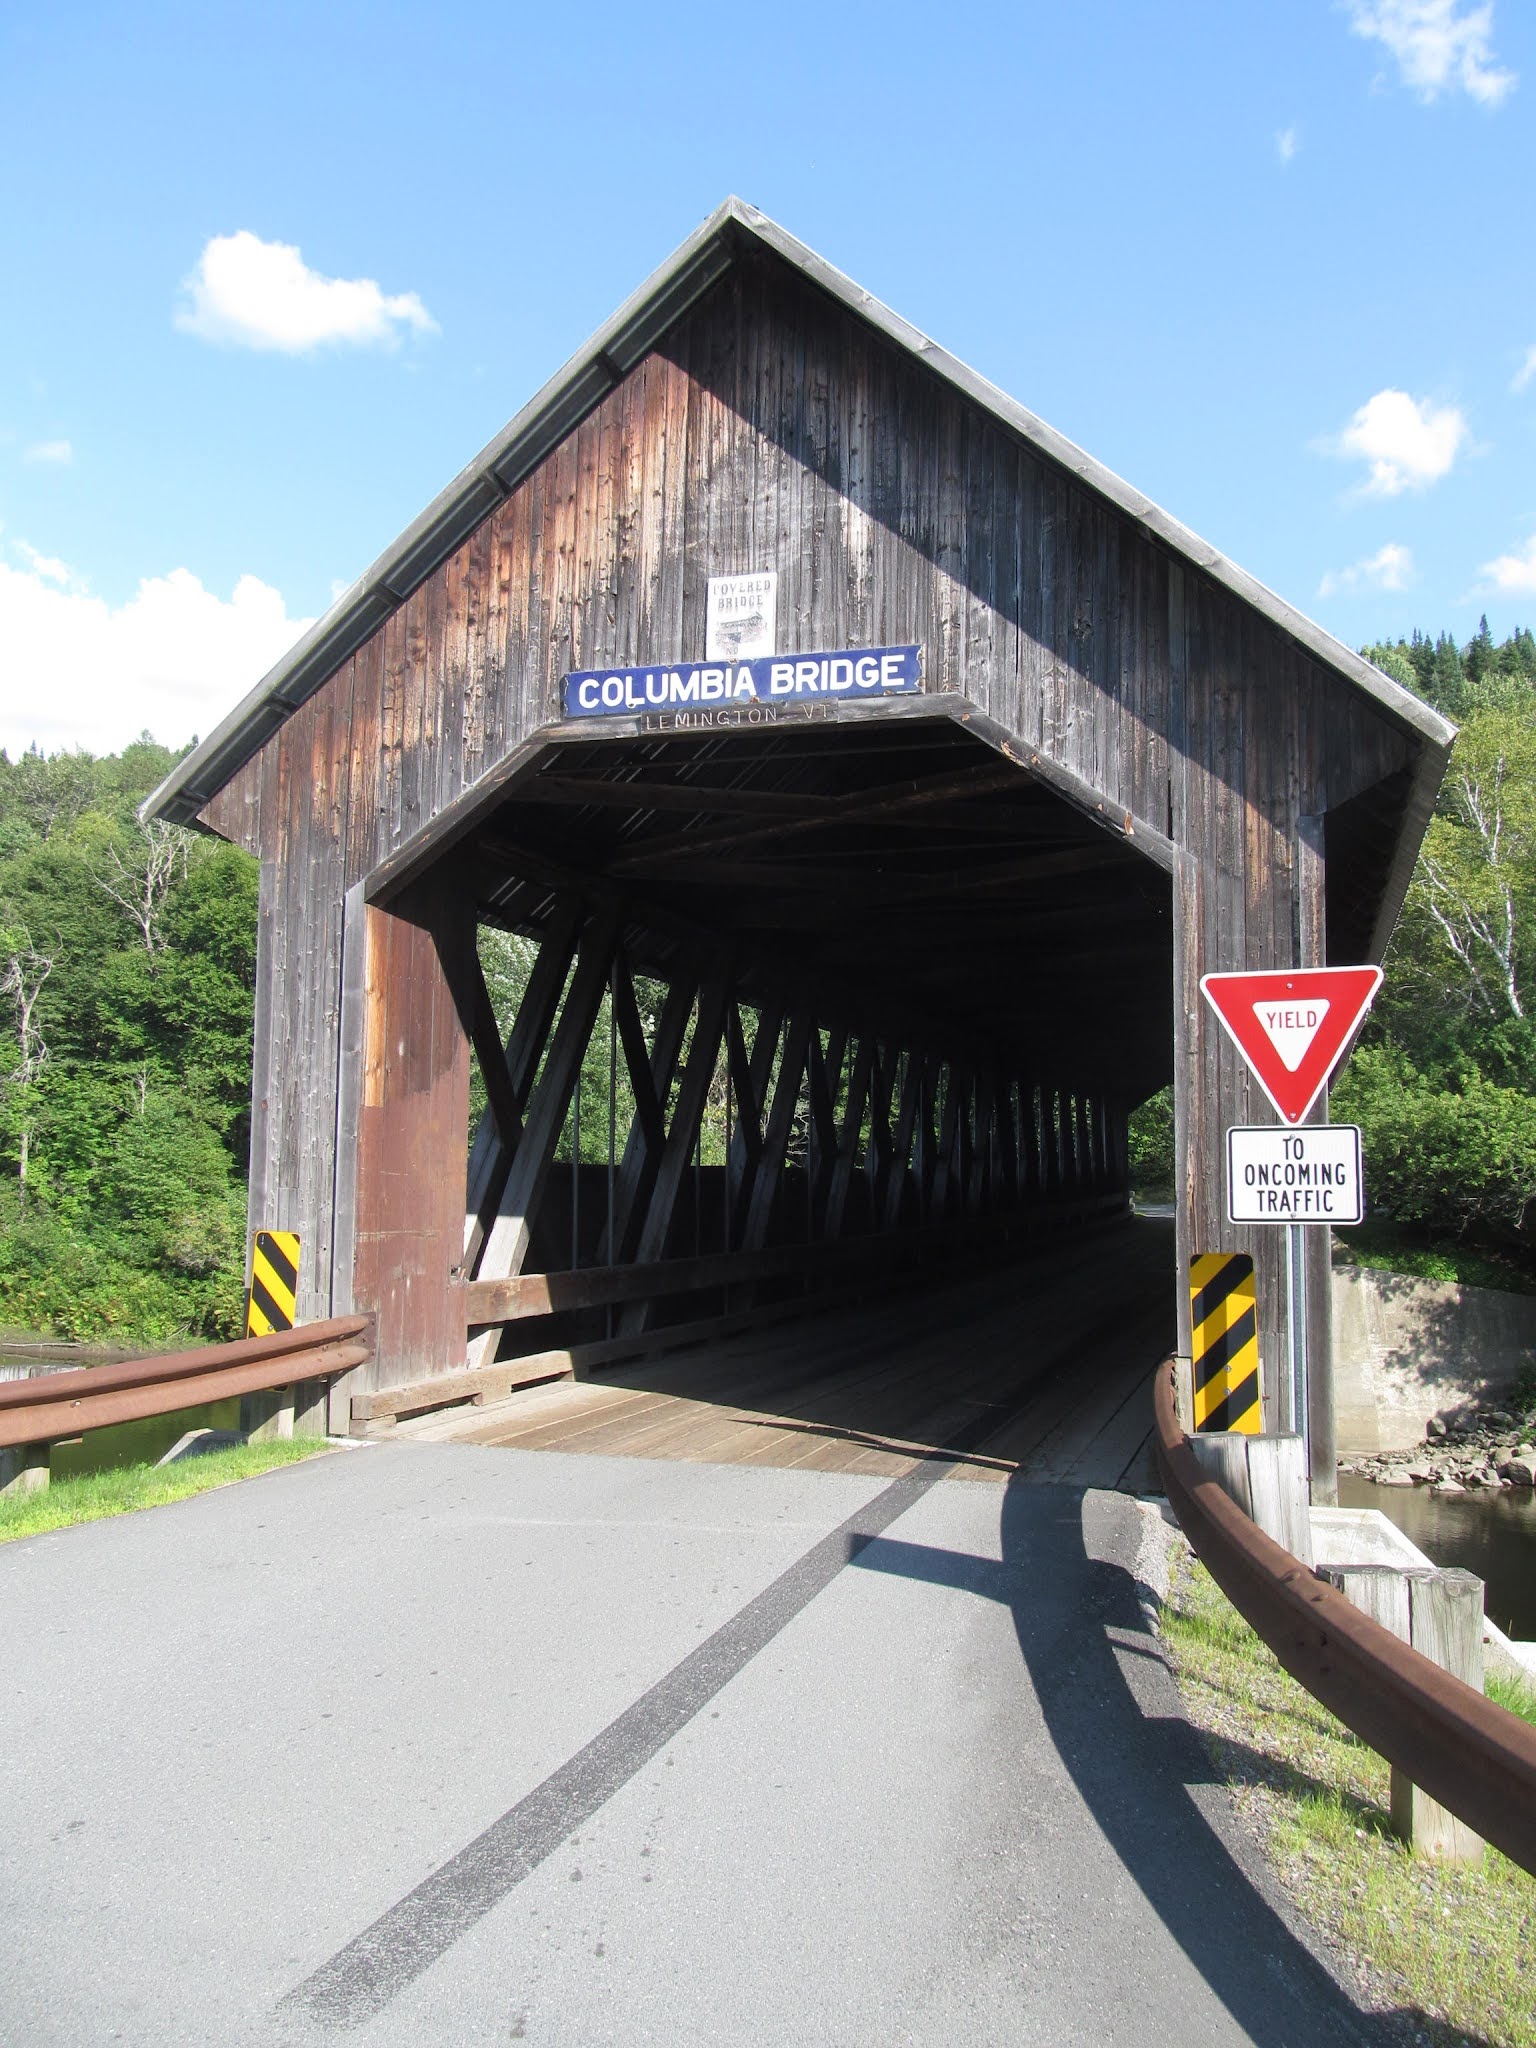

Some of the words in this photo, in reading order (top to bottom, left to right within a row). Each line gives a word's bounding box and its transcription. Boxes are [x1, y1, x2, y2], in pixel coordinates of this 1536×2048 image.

[713, 580, 771, 595] COVERED
[718, 595, 763, 609] BRIDGE
[578, 667, 756, 709] COLUMBIA
[770, 654, 905, 694] BRIDGE
[645, 708, 777, 731] LEMINGTON
[802, 703, 831, 719] VT
[1266, 1010, 1317, 1029] YIELD
[1283, 1138, 1304, 1160] TO
[1245, 1163, 1346, 1186] ONCOMING
[1257, 1190, 1333, 1212] TRAFFIC
